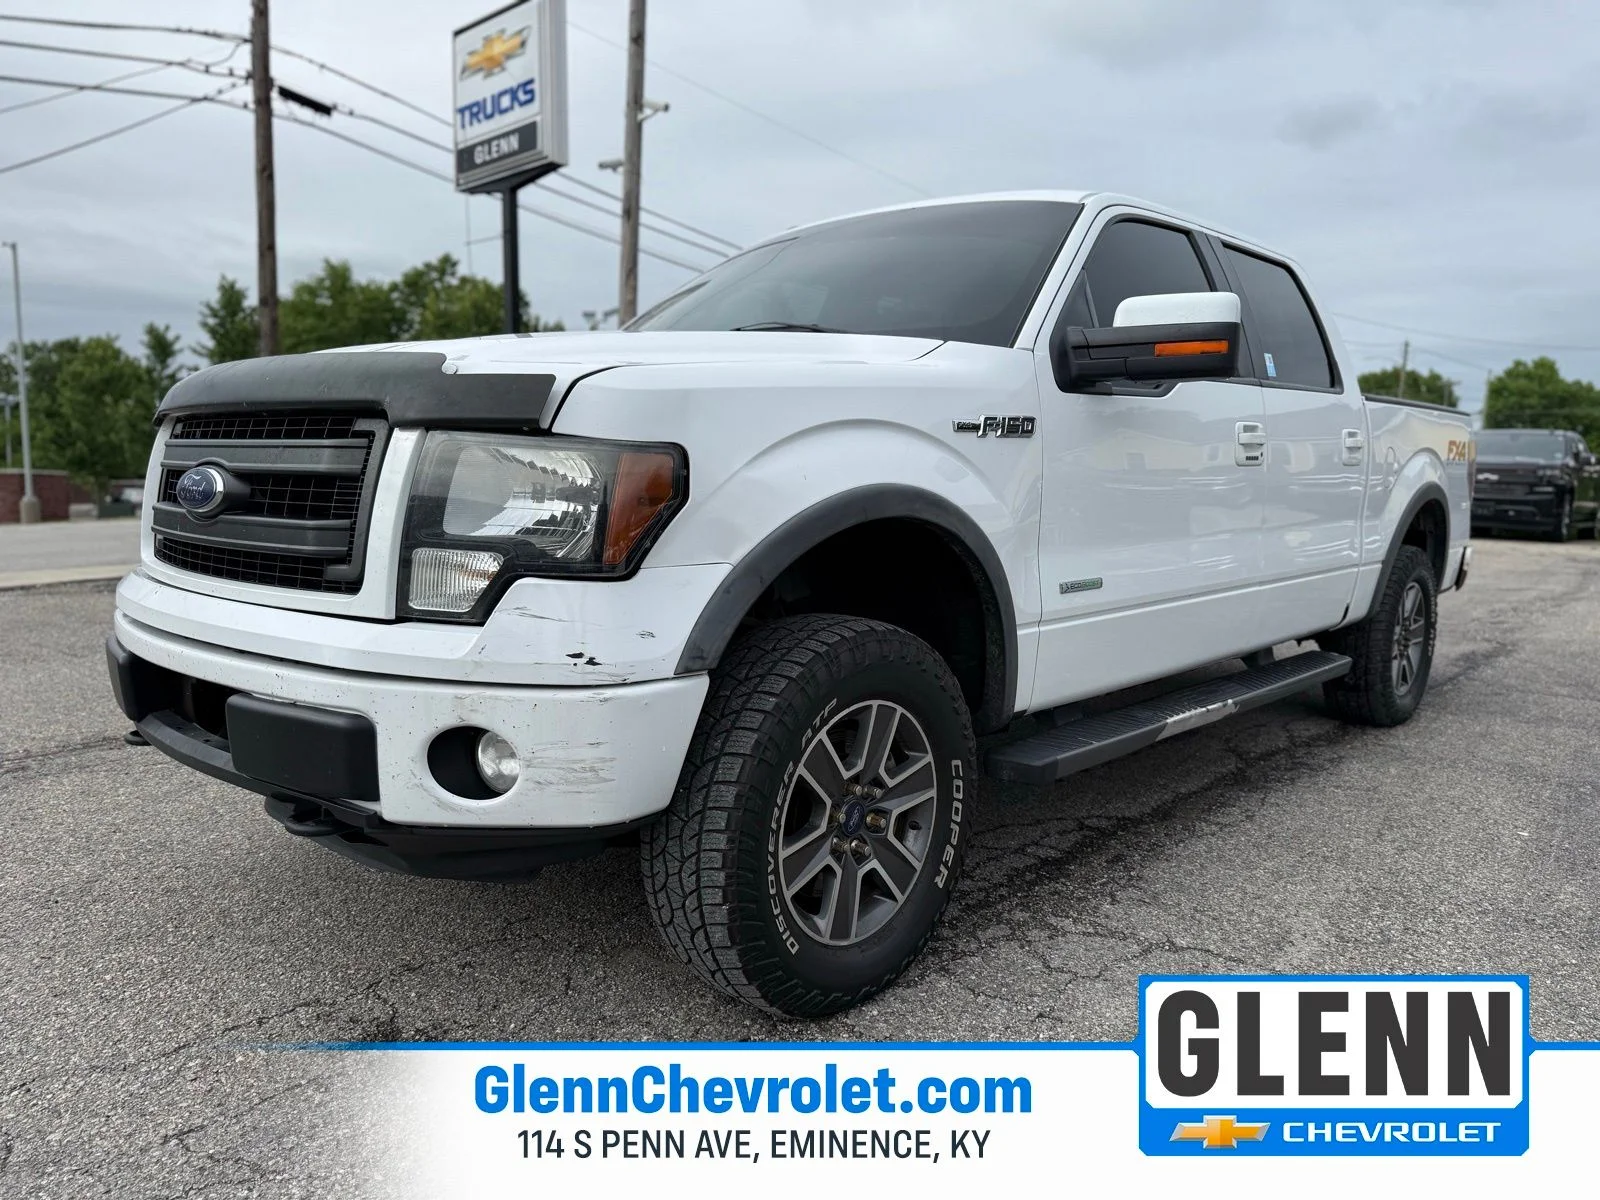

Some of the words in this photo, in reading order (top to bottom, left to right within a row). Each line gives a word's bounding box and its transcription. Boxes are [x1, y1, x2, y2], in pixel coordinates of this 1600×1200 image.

[456, 77, 536, 130] TRUCKS
[473, 132, 520, 165] GLENN
[978, 414, 1037, 438] F-150
[1447, 440, 1467, 462] FX4
[181, 473, 207, 499] Ford
[767, 760, 801, 956] DISCOVERER
[800, 697, 838, 752] ATP
[934, 759, 964, 889] COOPER
